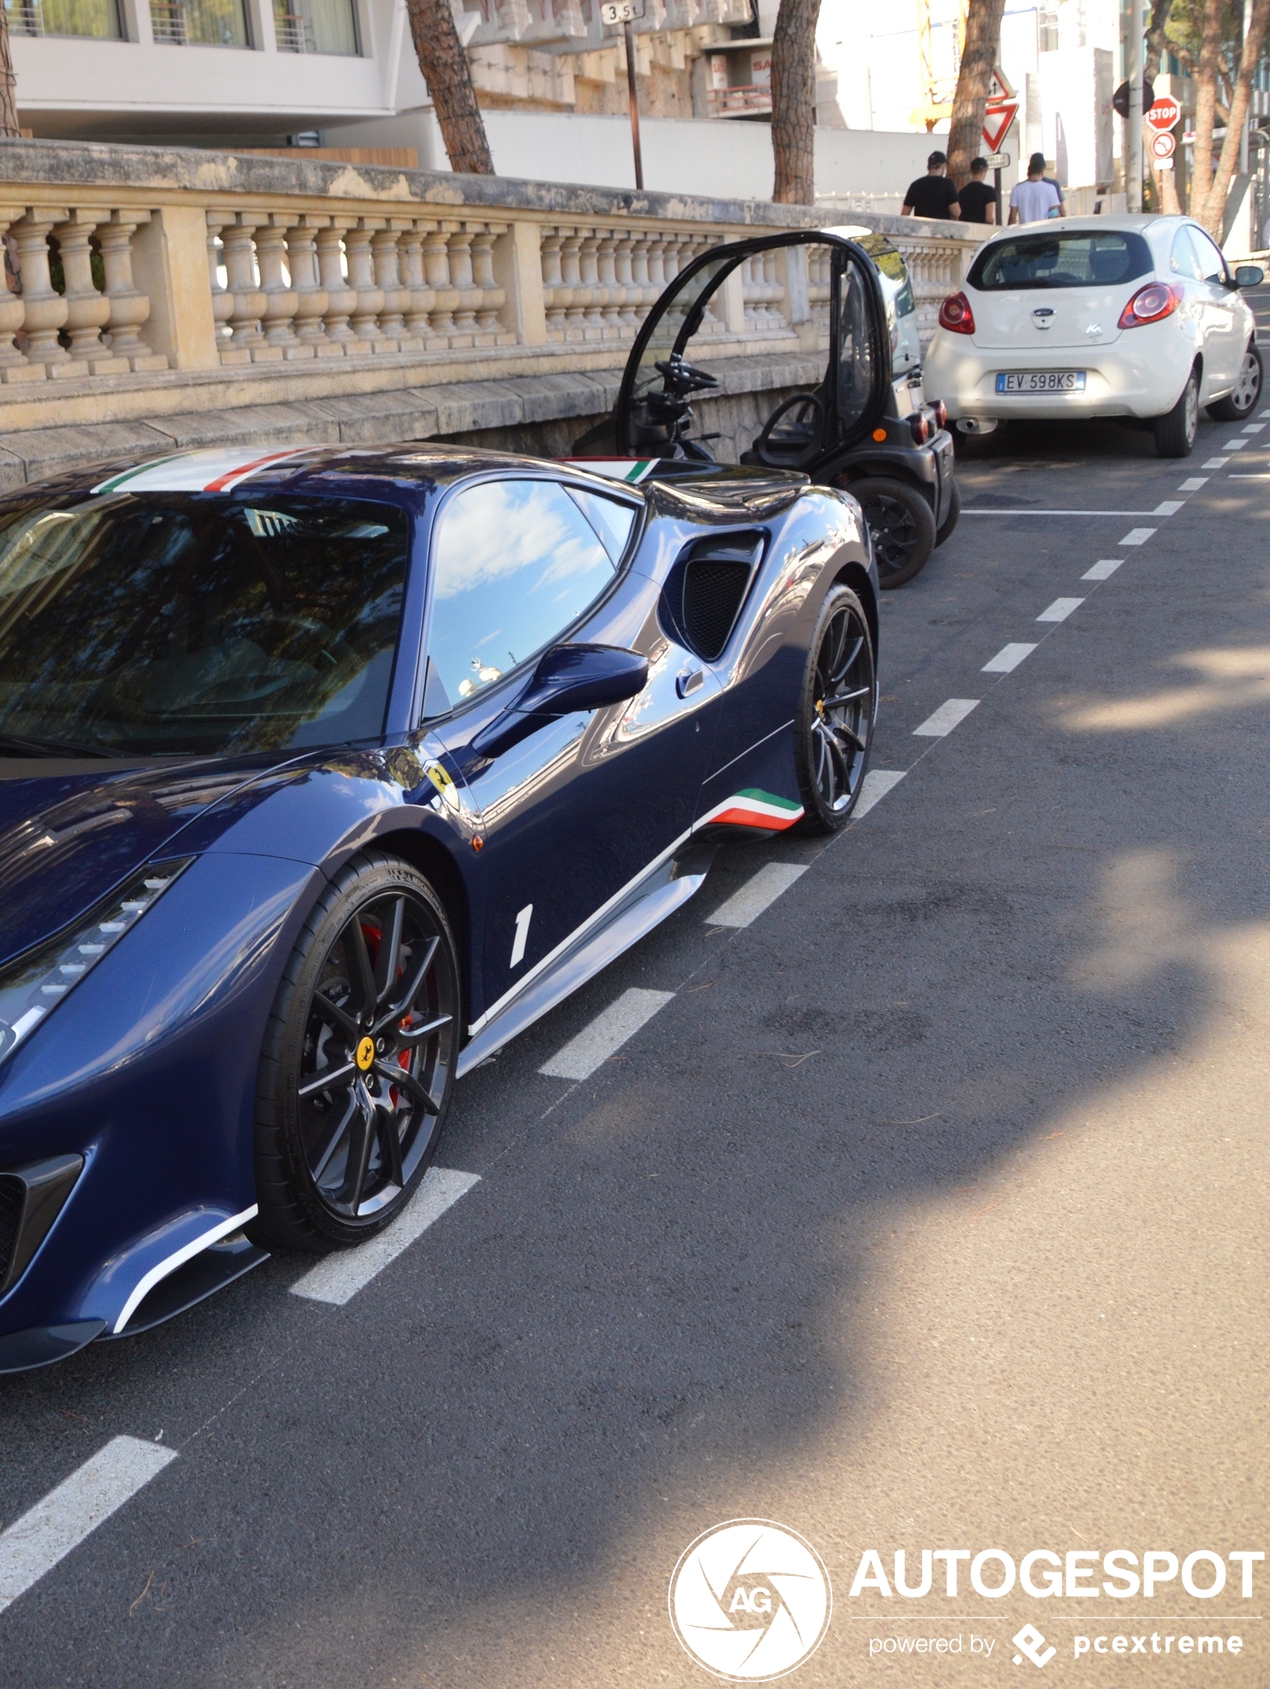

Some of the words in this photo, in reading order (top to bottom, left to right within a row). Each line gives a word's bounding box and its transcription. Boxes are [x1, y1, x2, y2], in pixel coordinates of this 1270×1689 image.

[1149, 107, 1176, 121] STOP
[1006, 375, 1025, 390] EV
[1030, 373, 1075, 389] 598KS
[510, 903, 533, 969] 1
